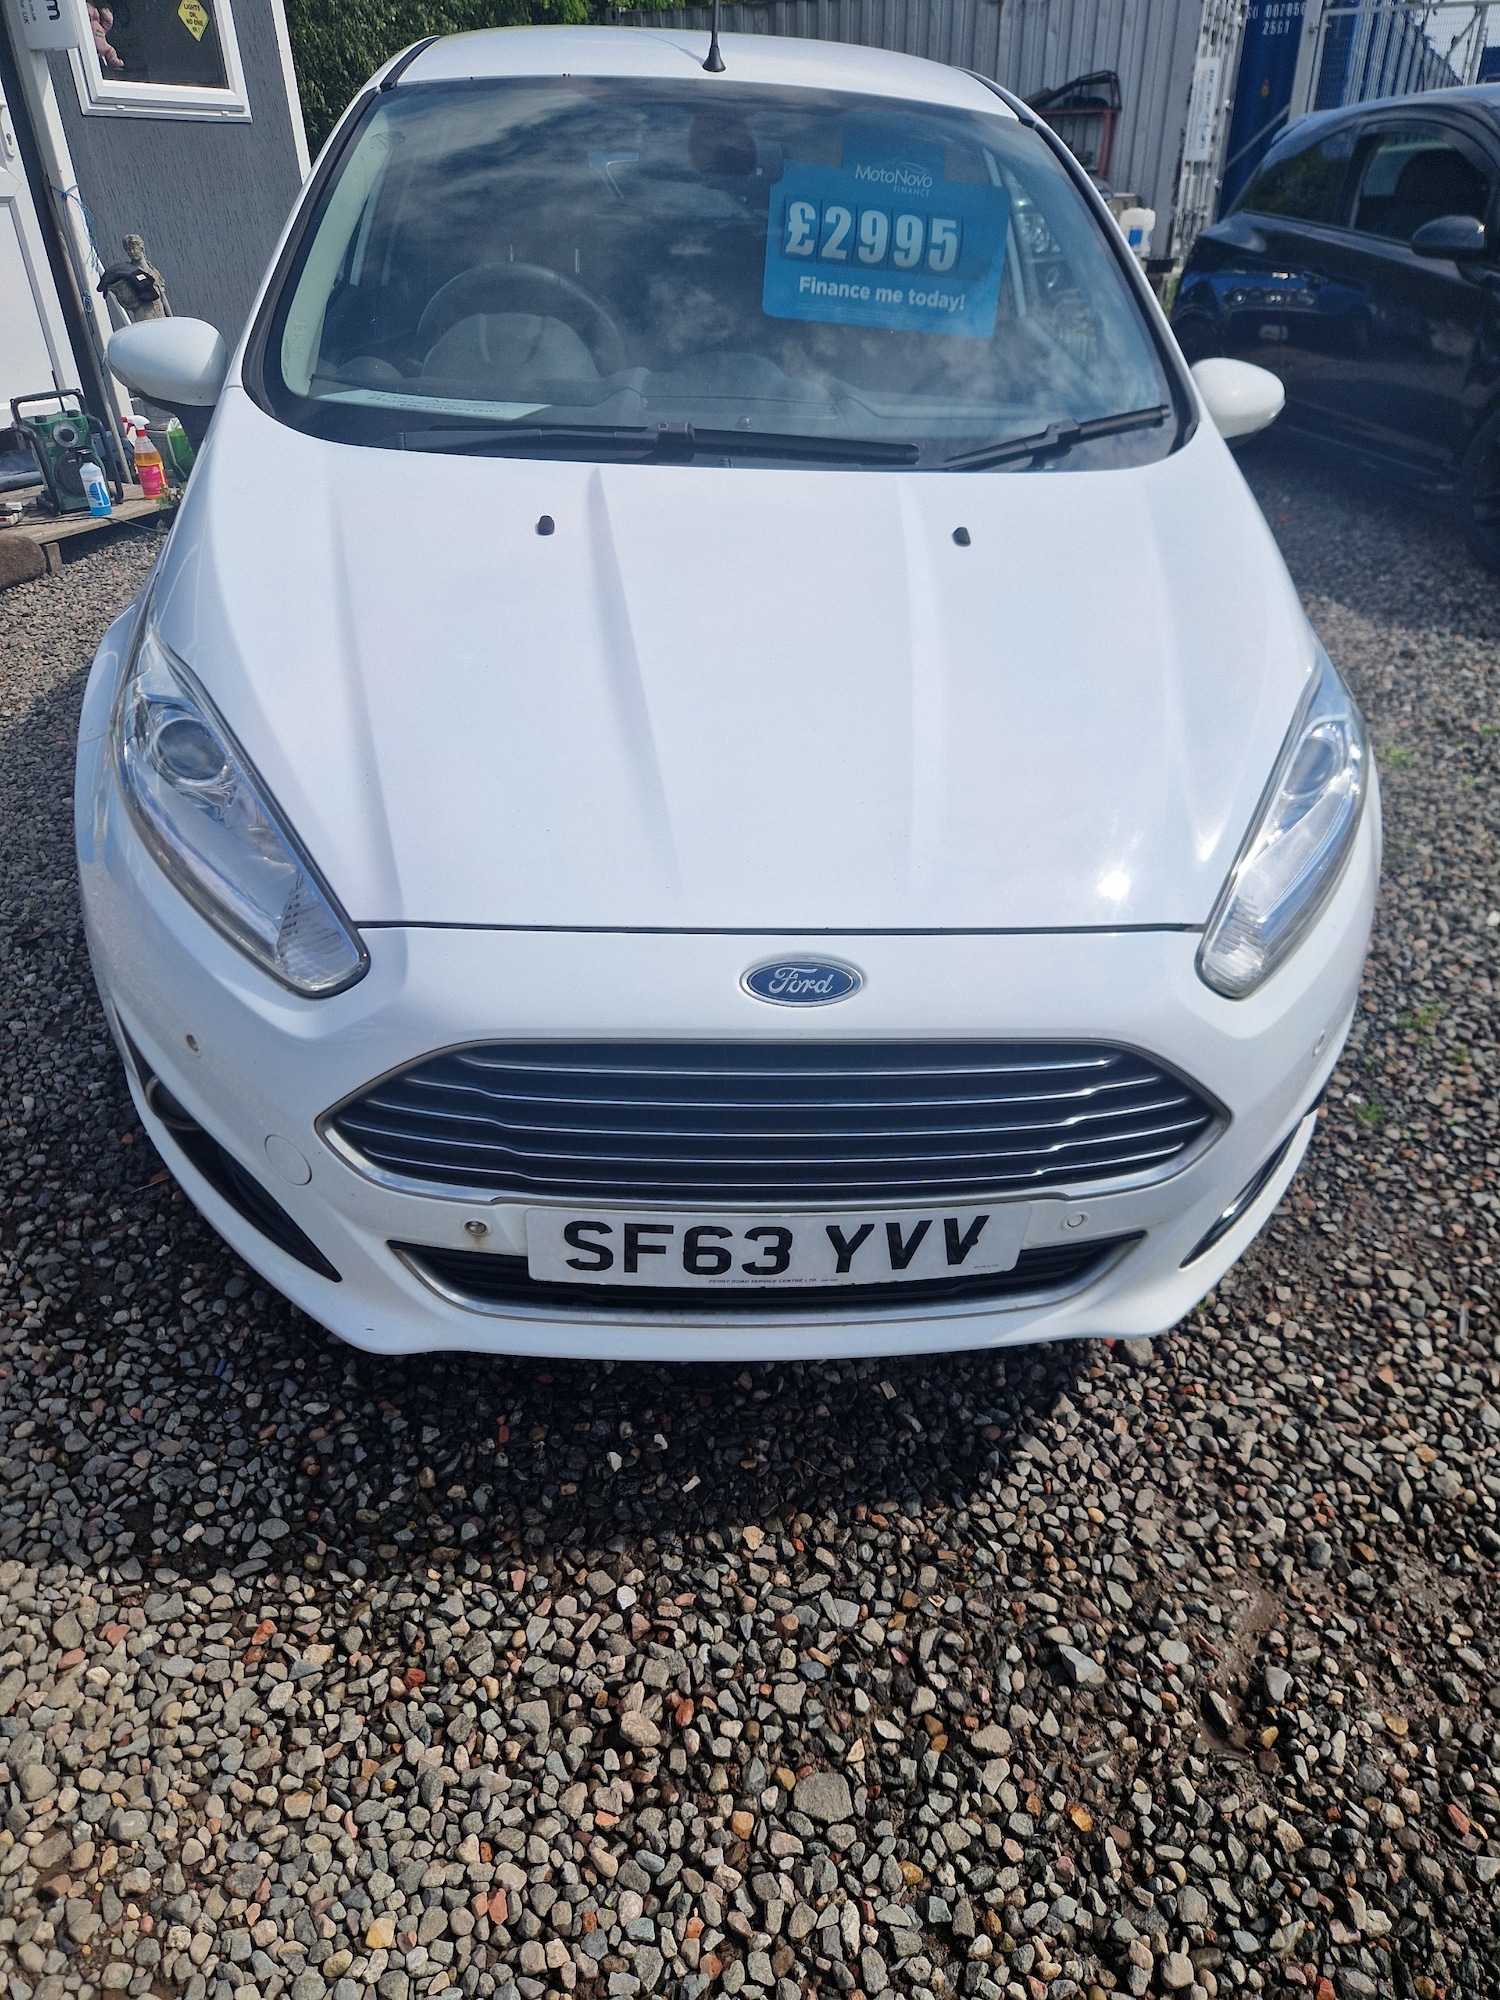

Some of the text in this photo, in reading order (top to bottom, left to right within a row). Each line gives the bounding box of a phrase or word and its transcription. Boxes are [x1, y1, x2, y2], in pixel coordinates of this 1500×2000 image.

[855, 163, 933, 189] MotoNovo
[893, 185, 931, 197] FINANCE
[785, 201, 959, 272] £2995
[799, 275, 966, 313] Finance me today!
[768, 967, 835, 994] Ford
[563, 1214, 991, 1275] SF63 YVV
